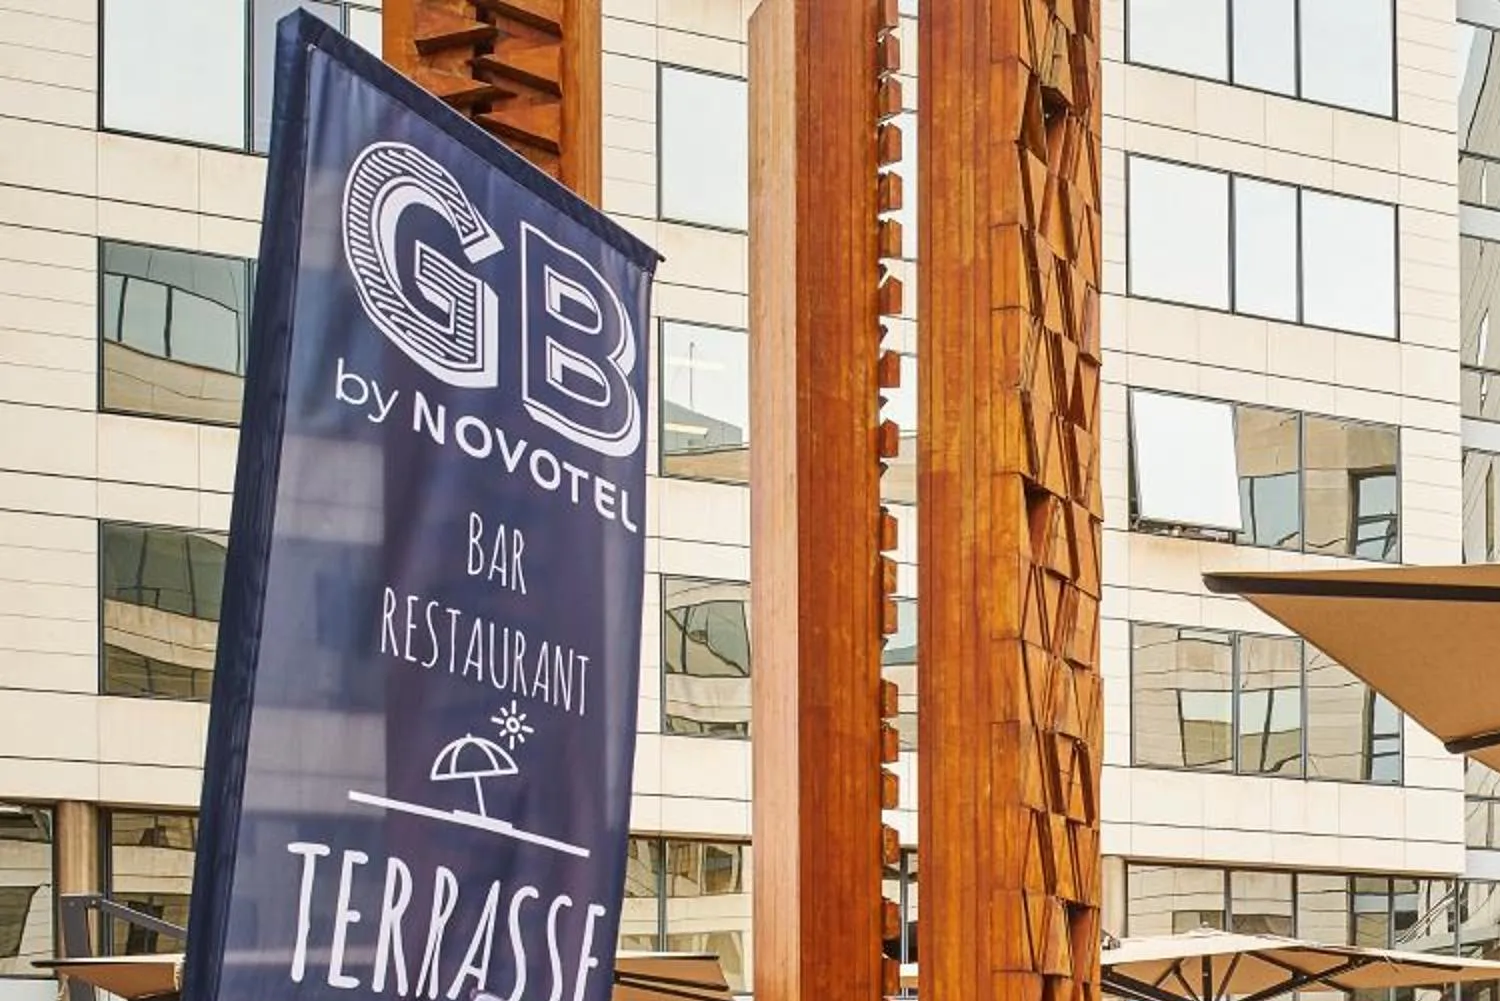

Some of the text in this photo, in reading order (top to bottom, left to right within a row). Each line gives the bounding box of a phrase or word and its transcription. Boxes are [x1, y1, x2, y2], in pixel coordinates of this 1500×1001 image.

[341, 141, 641, 458] GB
[335, 358, 637, 533] by NOVOTEL
[466, 511, 527, 595] BAR
[380, 585, 589, 715] RESTAURANT
